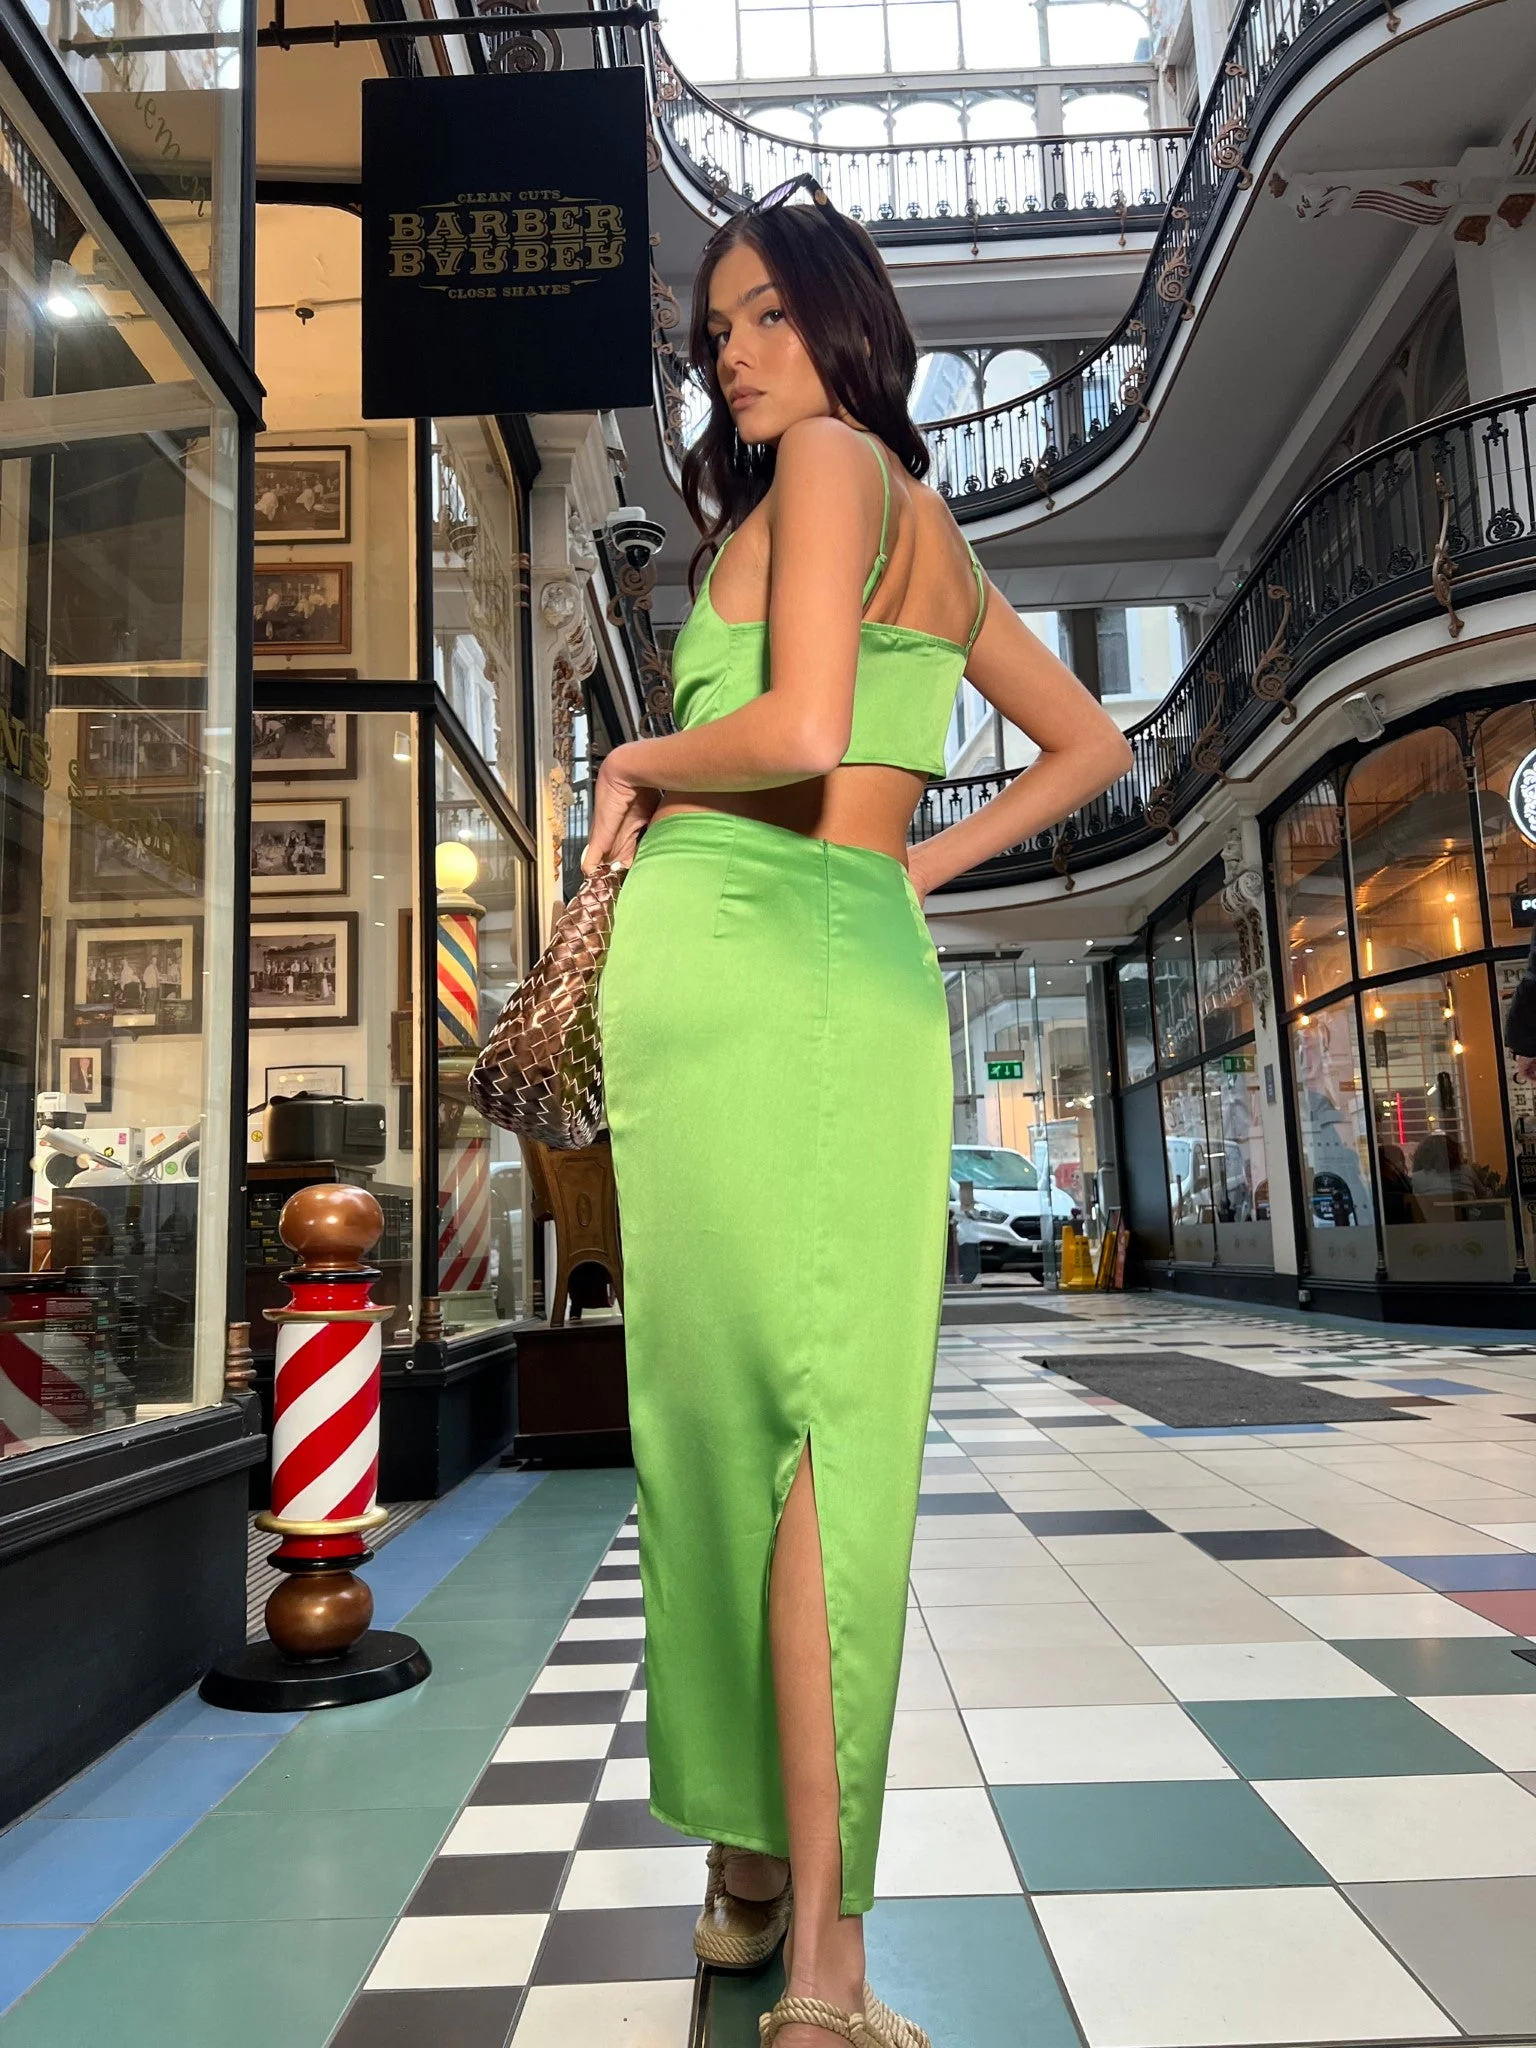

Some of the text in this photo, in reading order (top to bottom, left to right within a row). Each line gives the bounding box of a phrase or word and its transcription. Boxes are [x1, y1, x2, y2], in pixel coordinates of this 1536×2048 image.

[457, 190, 561, 204] CLEAN CUTS
[389, 205, 626, 244] BARBER
[448, 284, 571, 299] CLOSE SHAVES
